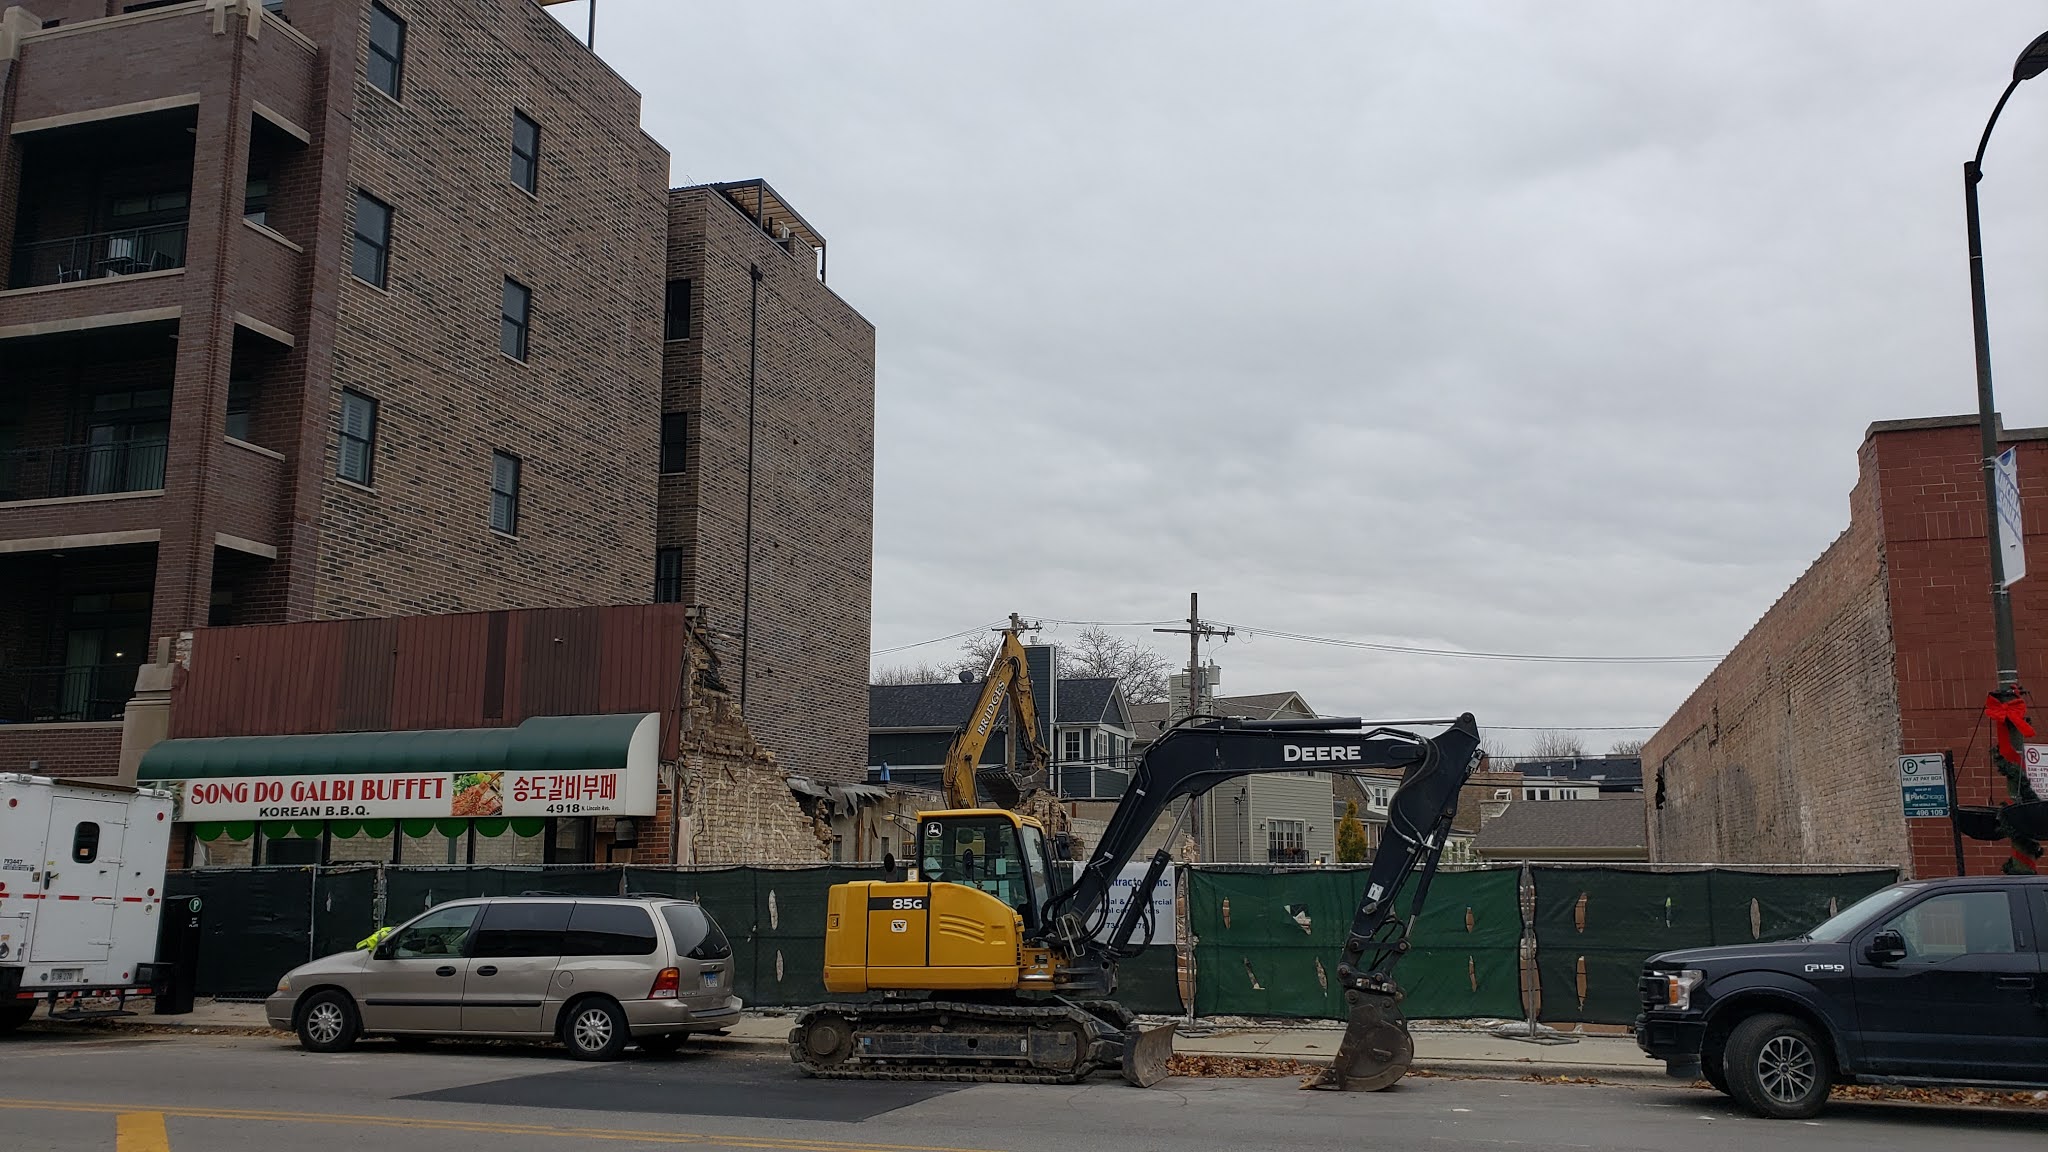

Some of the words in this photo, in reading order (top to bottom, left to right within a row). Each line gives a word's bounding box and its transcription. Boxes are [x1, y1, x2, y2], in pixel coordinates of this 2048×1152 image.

[977, 680, 1005, 736] BRIDGES
[1283, 744, 1361, 762] DEERE
[191, 782, 248, 804] SONG
[253, 781, 283, 803] DO
[290, 780, 354, 802] GALBI
[361, 777, 447, 801] BUFFET
[513, 774, 617, 802] 송도갈비부페
[259, 806, 320, 817] KOREAN
[325, 805, 370, 817] B.B.Q.
[546, 804, 580, 813] 4918
[1156, 879, 1171, 887] nc.
[892, 898, 923, 910] 85G
